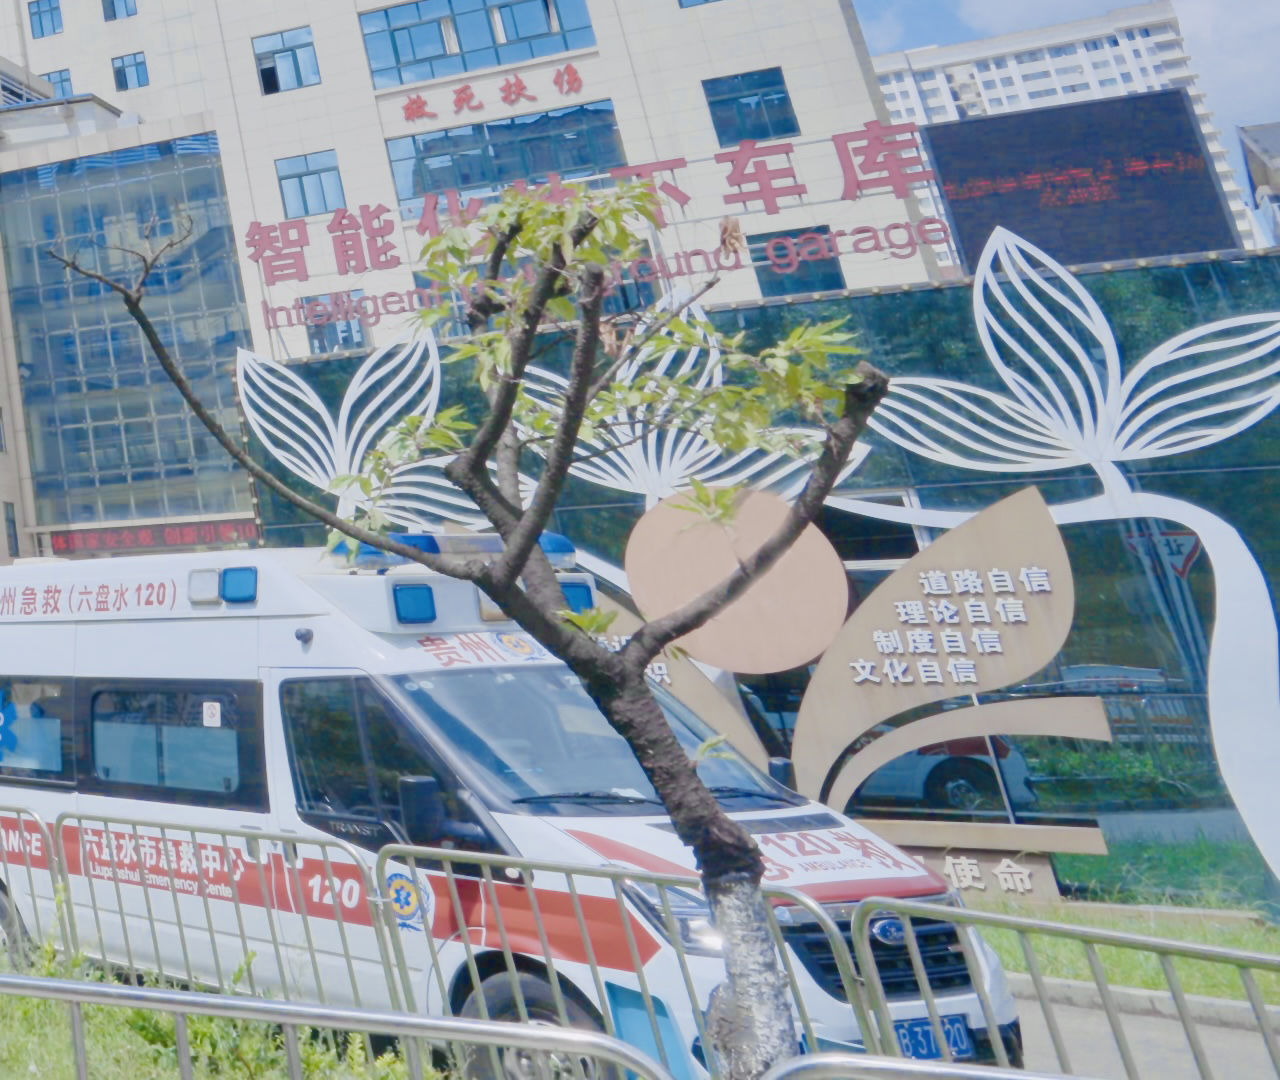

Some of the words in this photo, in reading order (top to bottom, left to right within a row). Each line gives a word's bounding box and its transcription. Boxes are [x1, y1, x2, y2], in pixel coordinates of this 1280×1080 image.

[401, 63, 583, 122] 救死扶伤
[245, 121, 936, 286] 智能化下车库
[764, 217, 951, 274] garage
[919, 566, 1052, 595] 道路自信
[894, 597, 1028, 624] 理论自信
[416, 632, 508, 669] 贵州
[873, 627, 1003, 654] 制度自信
[849, 658, 978, 684] 文化自信
[308, 874, 360, 909] 120
[913, 854, 1033, 893] 使命
